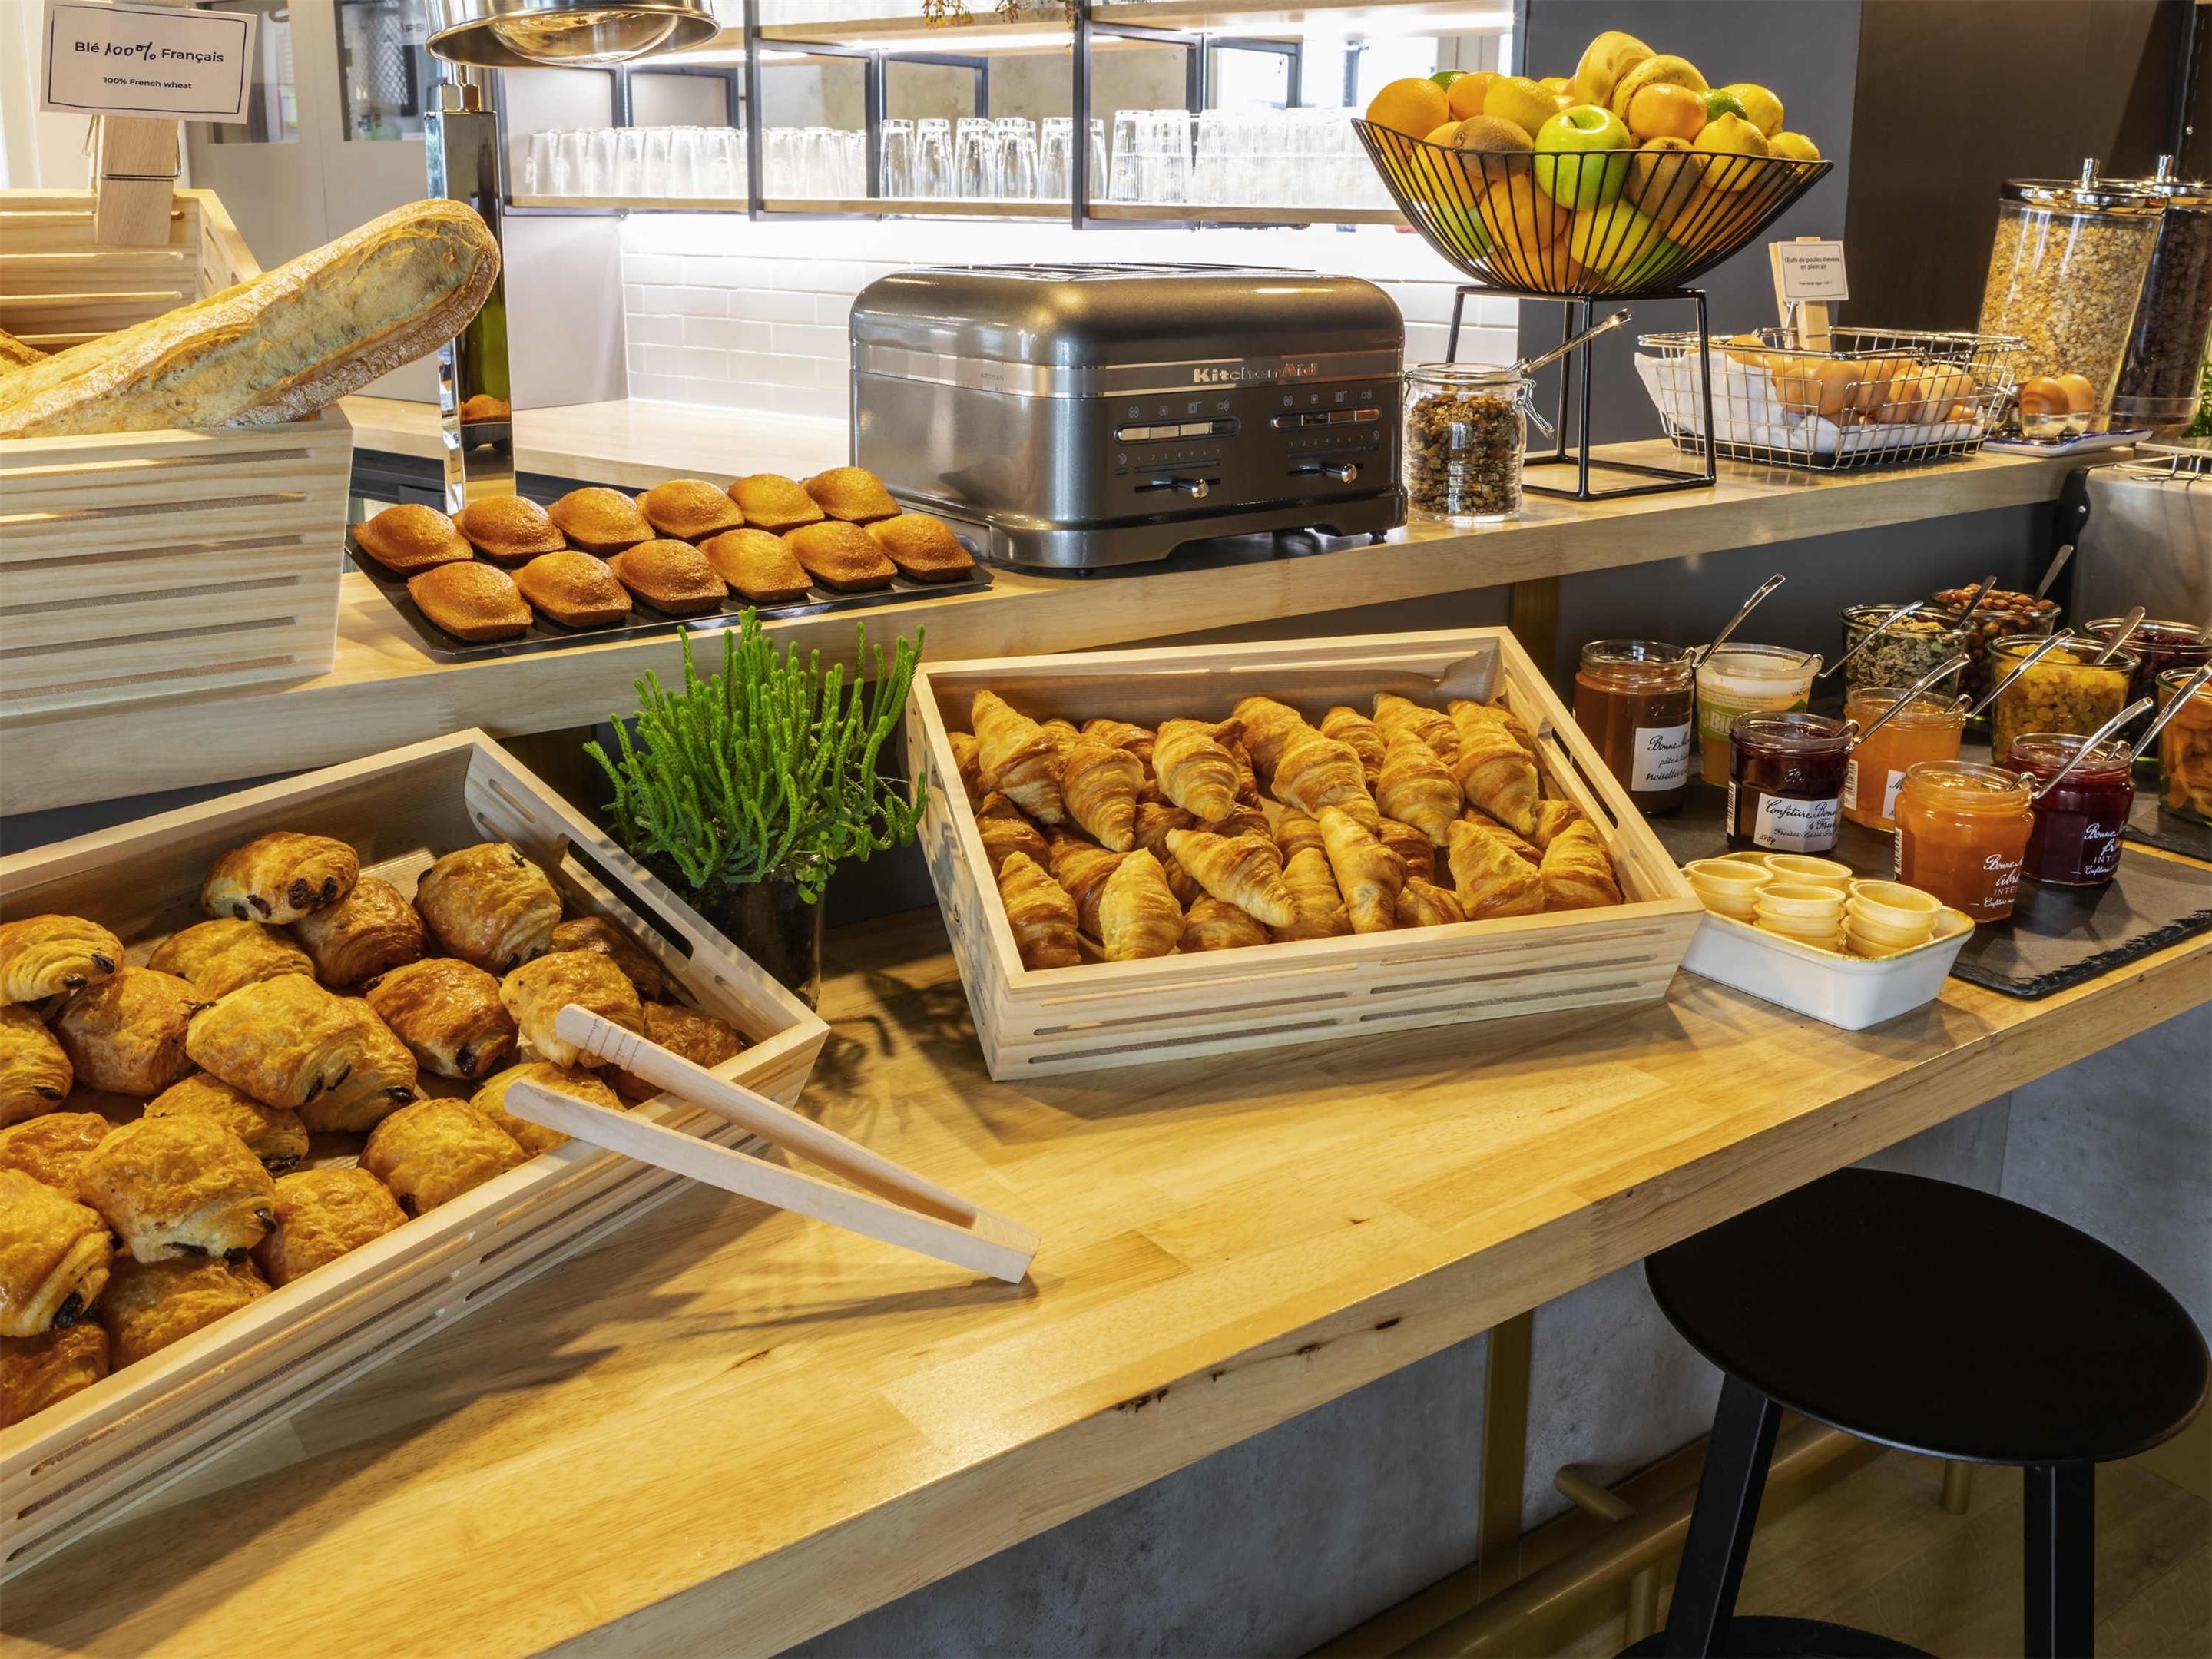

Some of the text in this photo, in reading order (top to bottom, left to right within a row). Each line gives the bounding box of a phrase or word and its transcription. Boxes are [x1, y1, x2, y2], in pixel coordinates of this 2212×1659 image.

[74, 41, 224, 63] Blé 100% Français
[103, 76, 192, 89] 100% French wheat
[1193, 363, 1319, 383] KitchenAid
[1765, 799, 1813, 820] Confiture
